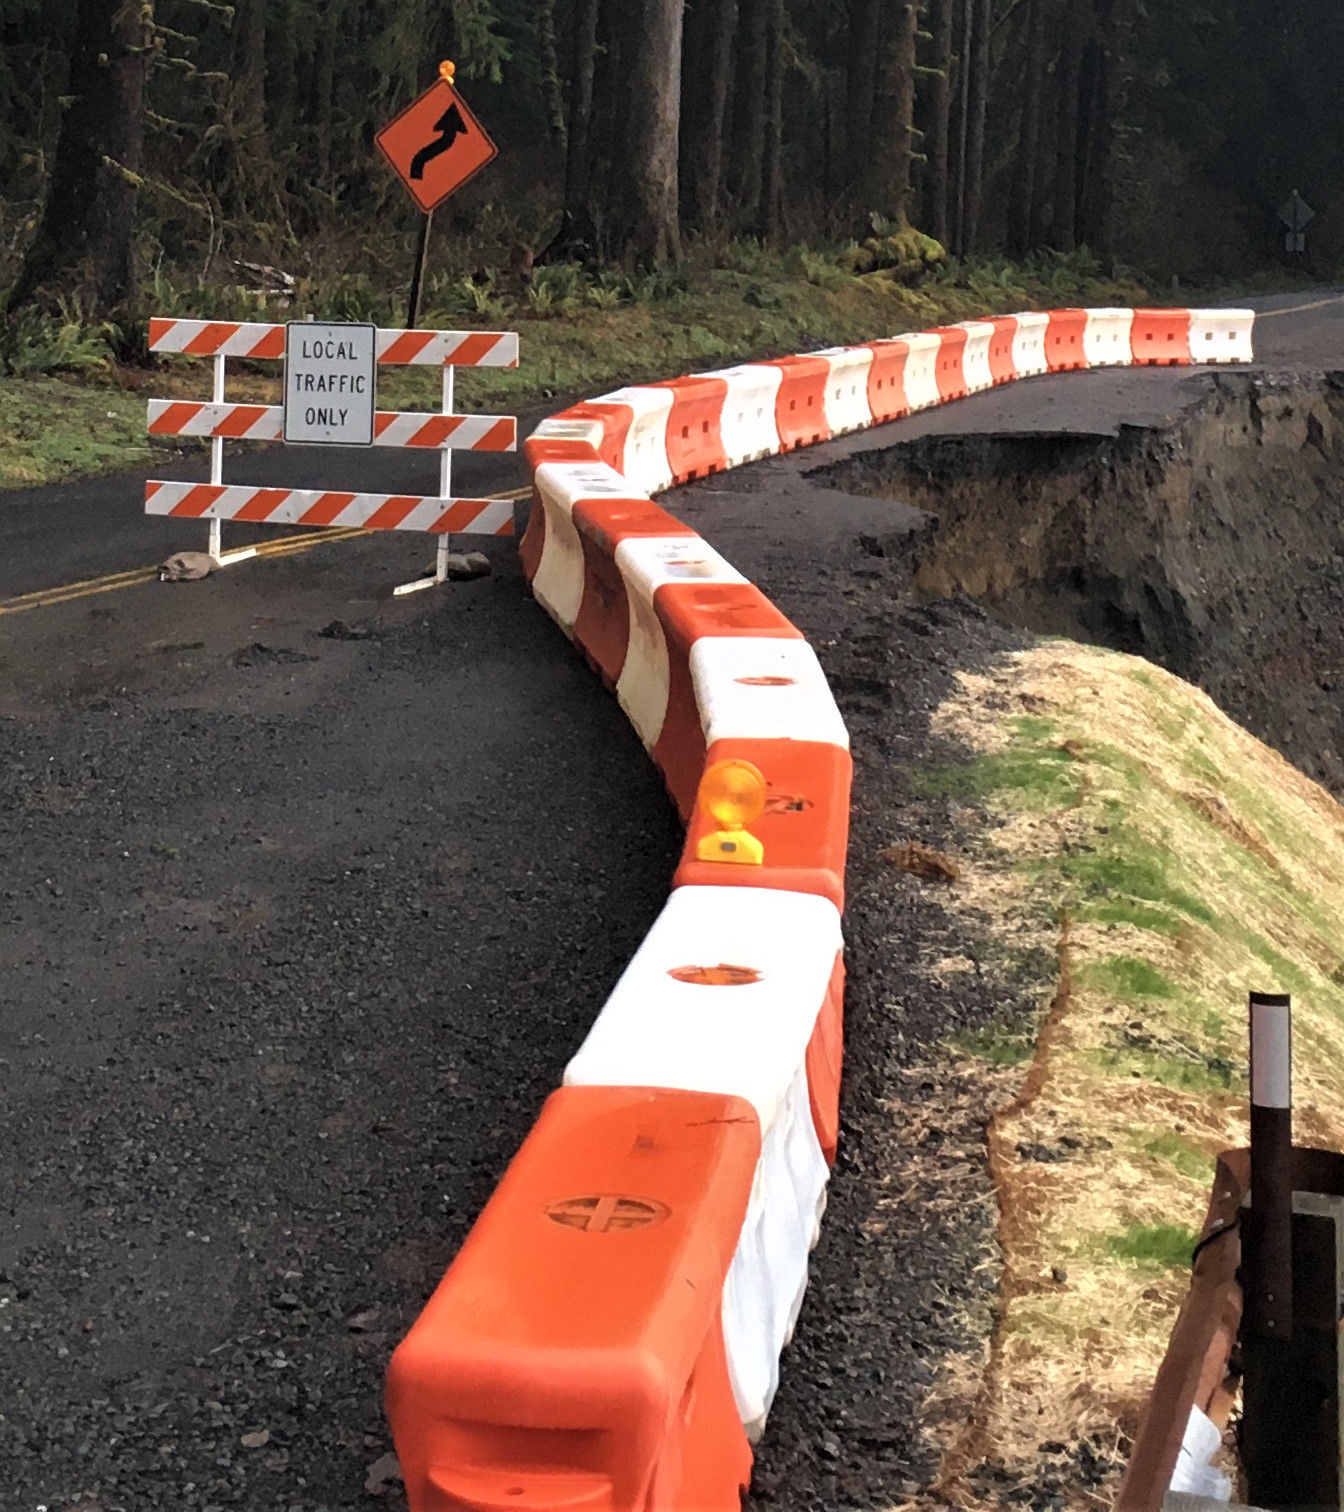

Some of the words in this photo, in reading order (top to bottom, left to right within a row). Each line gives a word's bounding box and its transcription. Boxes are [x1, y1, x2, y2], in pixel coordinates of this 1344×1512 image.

[302, 340, 358, 361] LOCAL
[294, 373, 366, 394] TRAFFIC
[305, 407, 349, 426] ONLY
